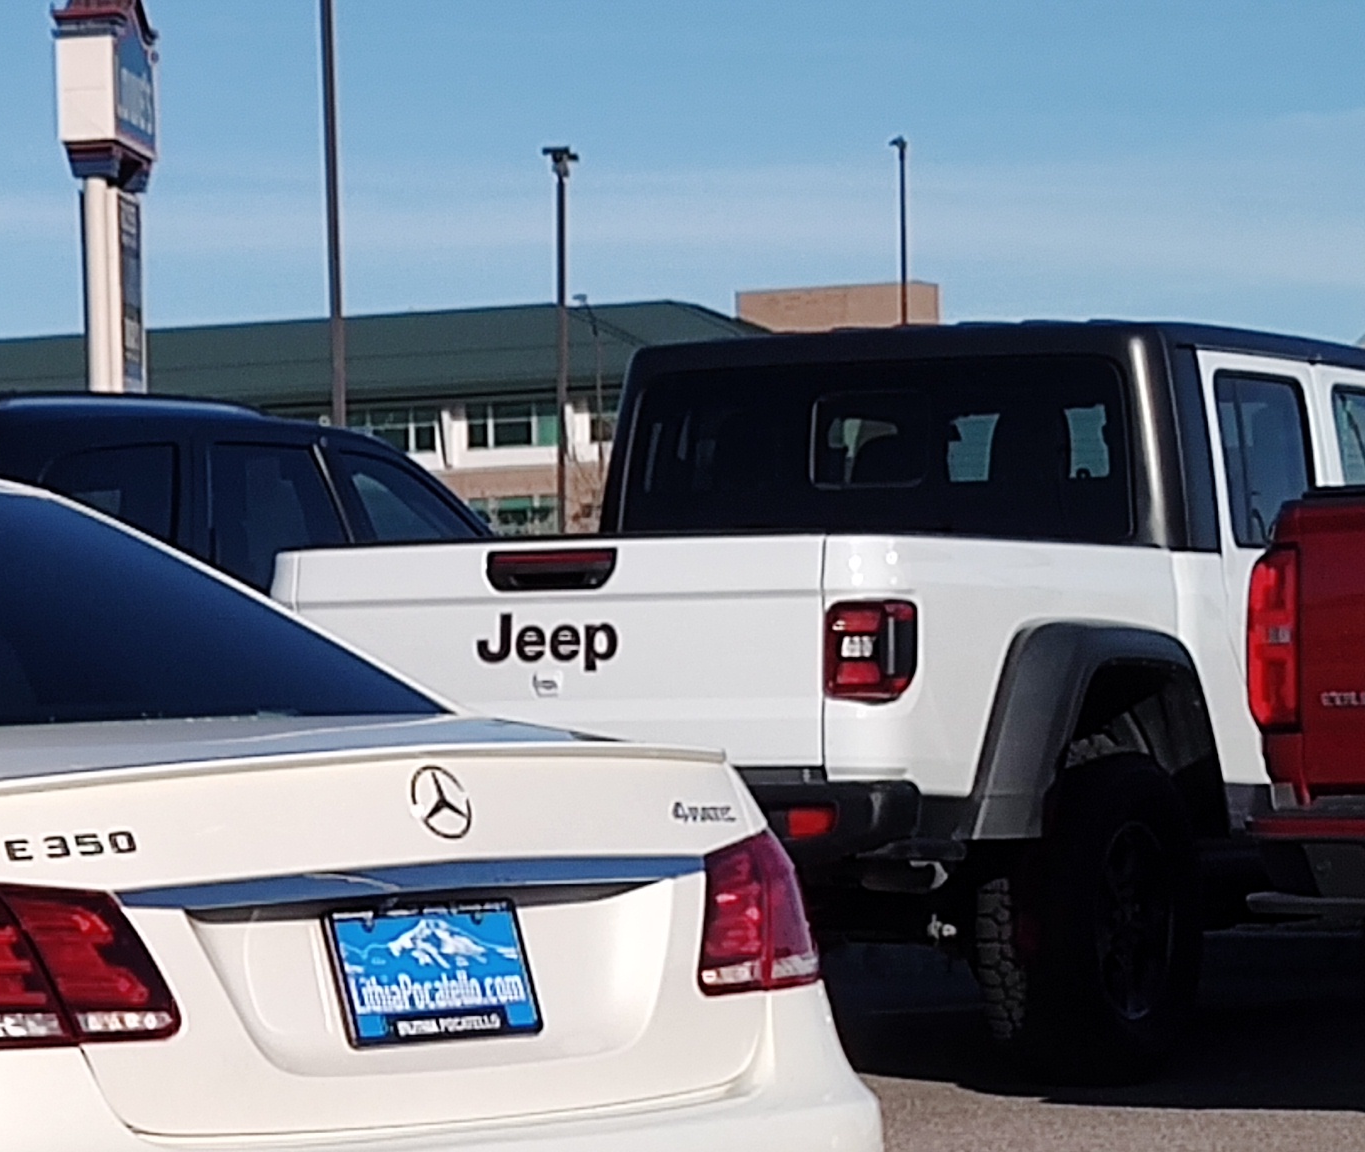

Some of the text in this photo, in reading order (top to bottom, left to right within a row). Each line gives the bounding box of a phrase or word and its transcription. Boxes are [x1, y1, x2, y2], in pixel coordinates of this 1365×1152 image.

[477, 612, 618, 672] Jeep
[4, 831, 137, 861] E 350
[351, 970, 525, 1013] LithiaPocatello.com
[439, 1014, 501, 1033] POCATELLO
